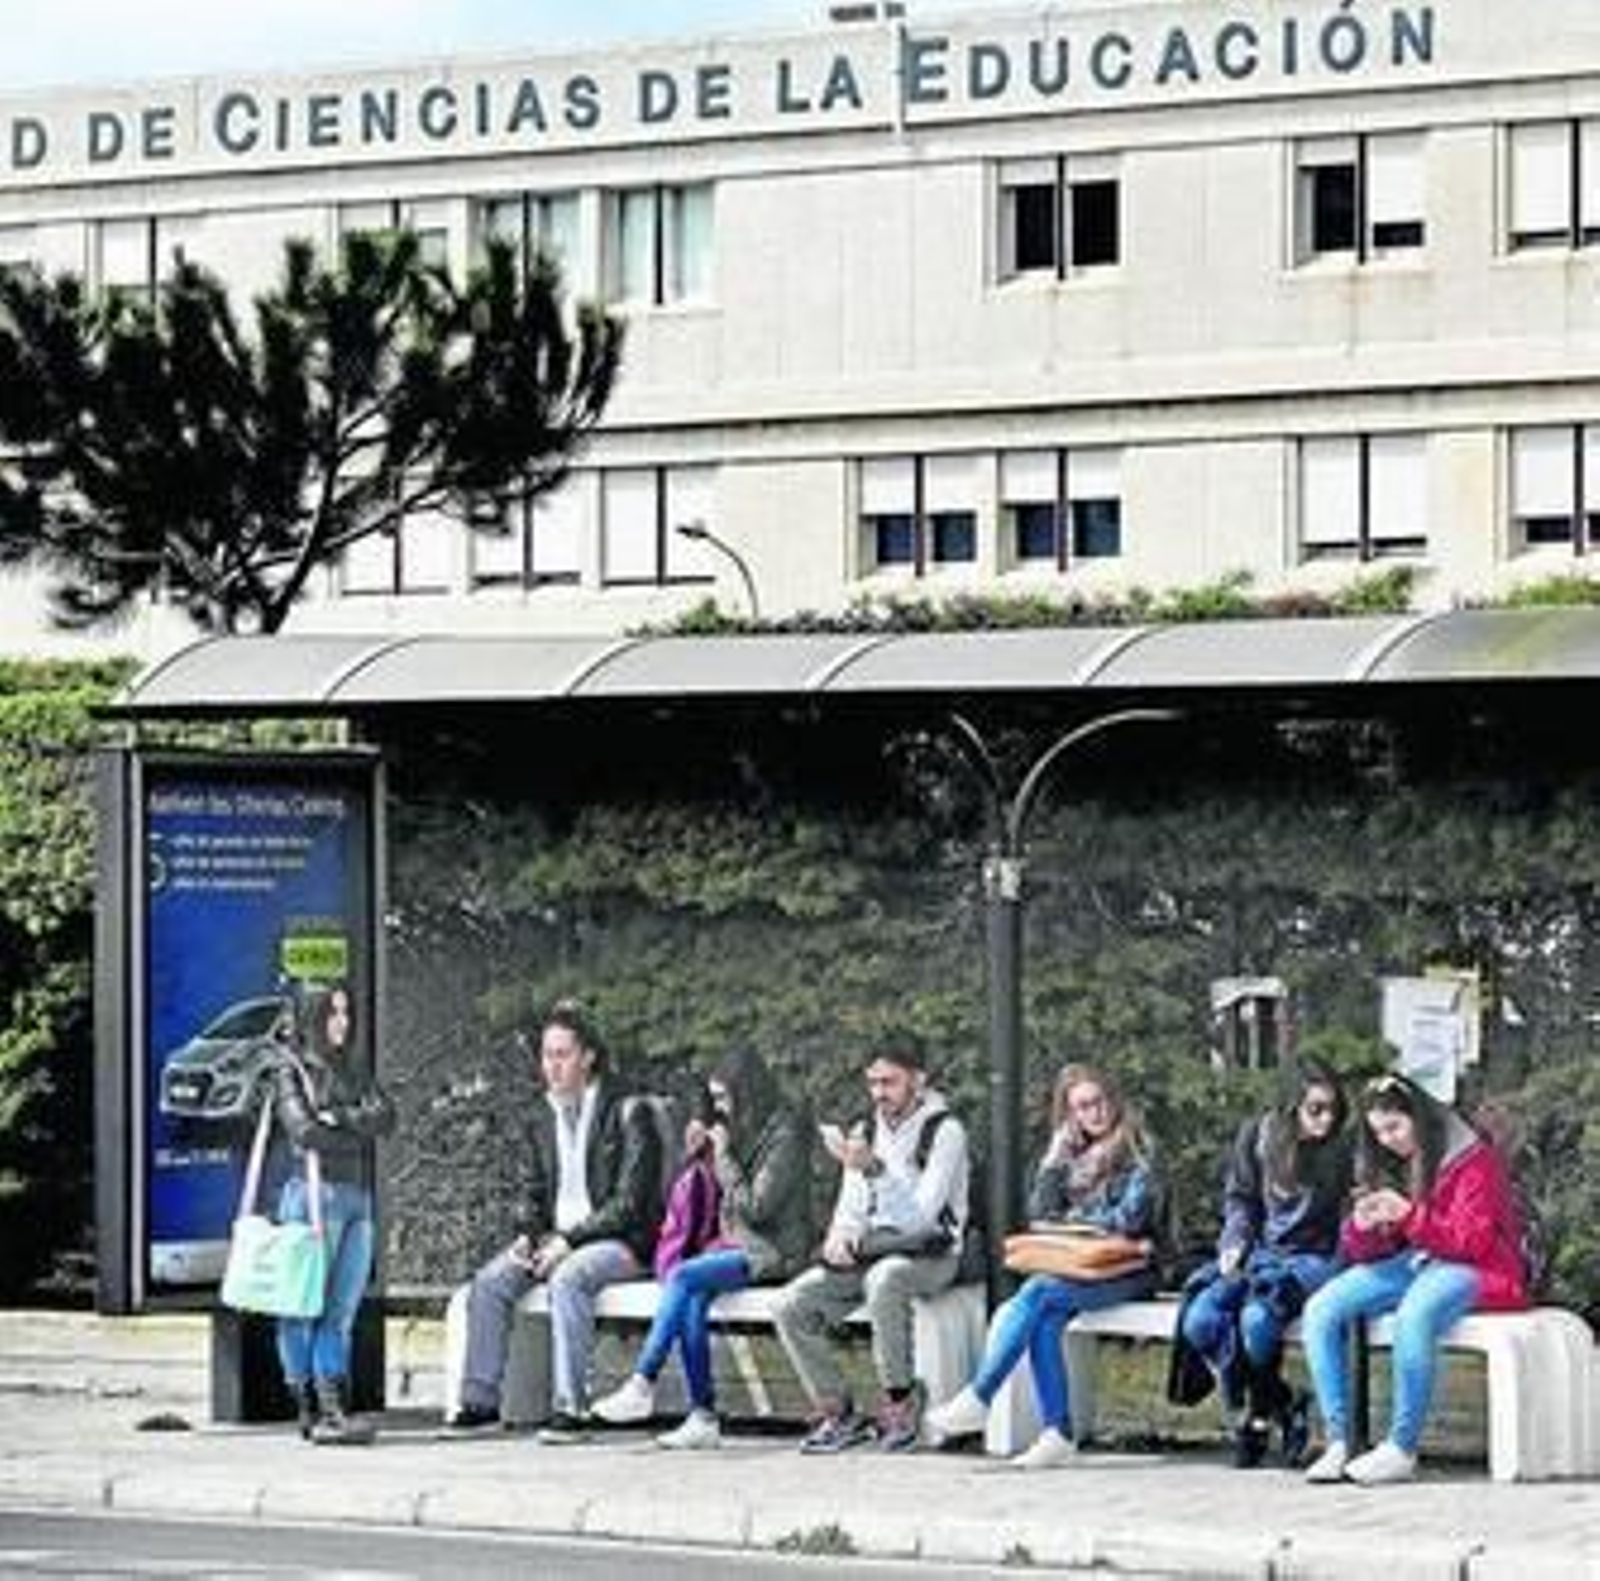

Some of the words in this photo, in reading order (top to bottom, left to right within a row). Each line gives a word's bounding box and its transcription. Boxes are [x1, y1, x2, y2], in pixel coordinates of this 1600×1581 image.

[87, 107, 176, 164] DE
[213, 75, 601, 155] CIENCIAS
[638, 64, 733, 124] DE
[776, 56, 865, 114] LA
[900, 0, 1435, 105] EDUCACIÓN
